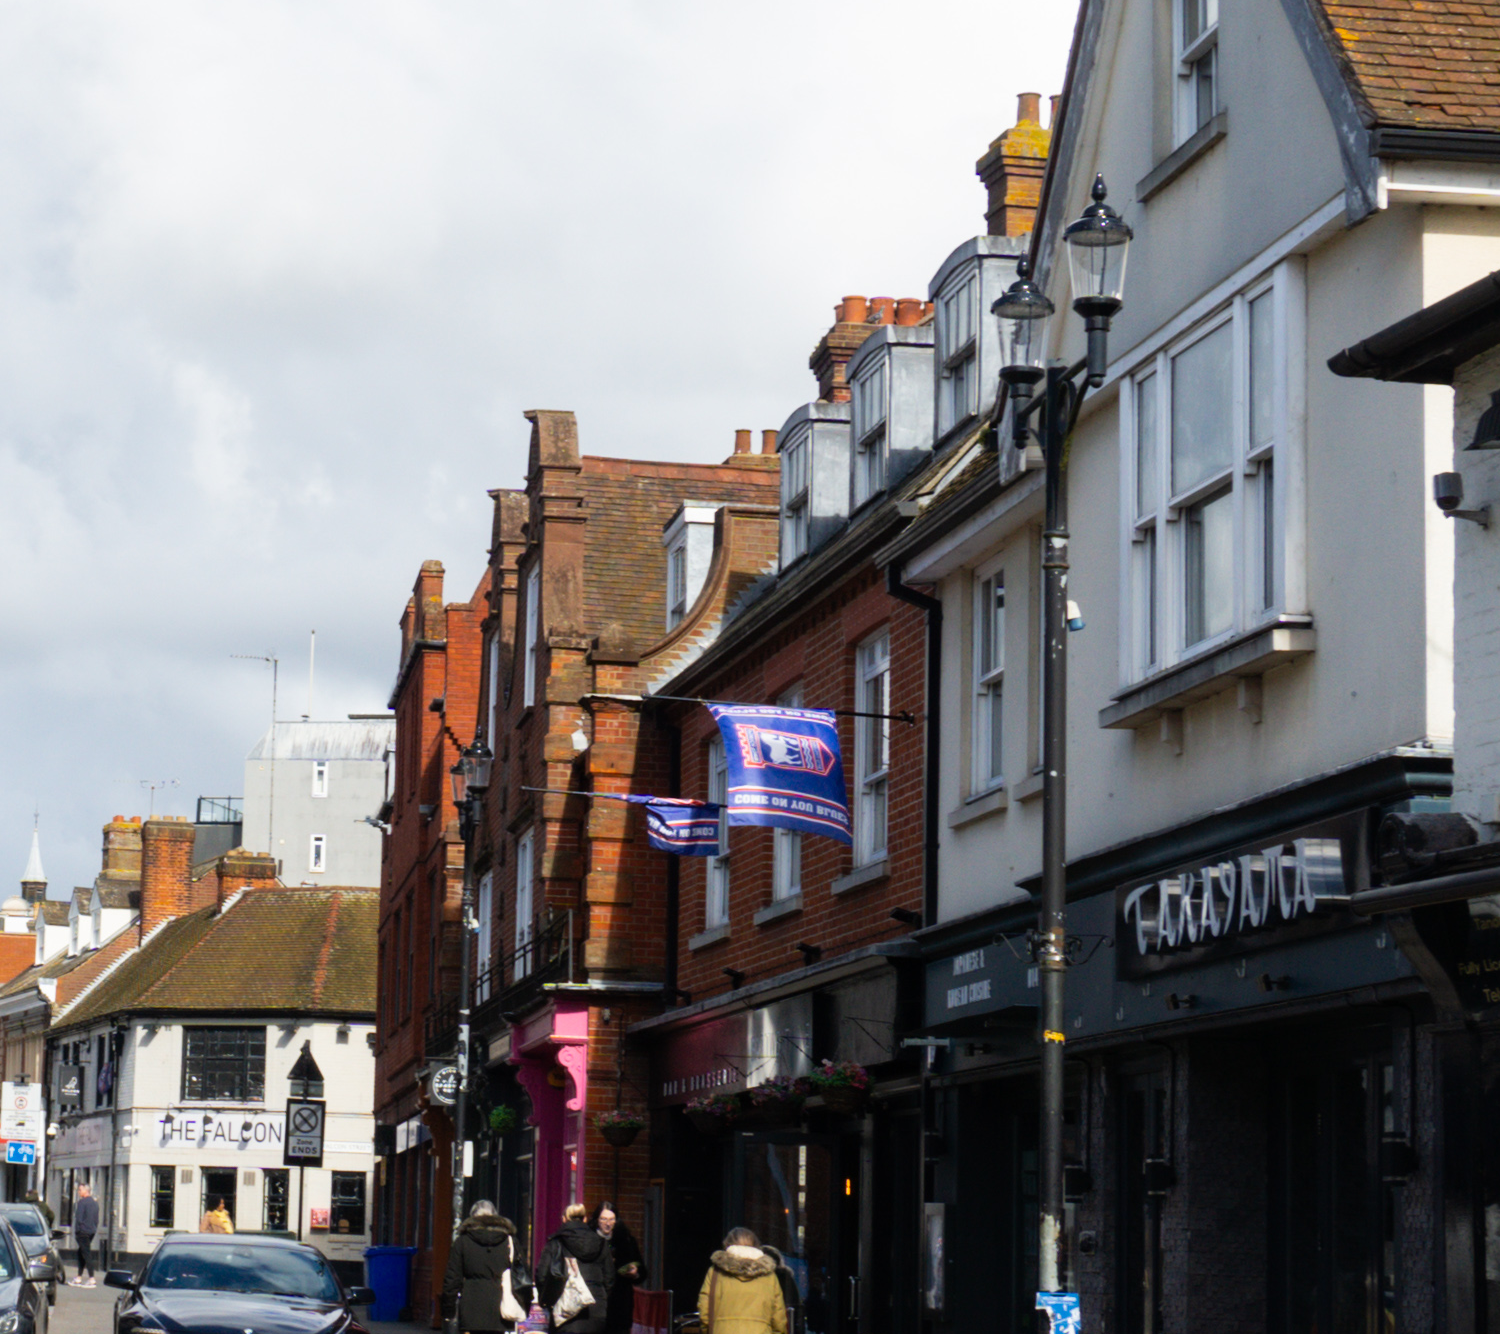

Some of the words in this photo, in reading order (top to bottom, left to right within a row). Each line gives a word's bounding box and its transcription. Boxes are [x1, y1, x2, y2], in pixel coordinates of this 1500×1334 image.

[1124, 837, 1330, 956] TAKAYAMA
[1458, 962, 1481, 976] Fully
[159, 1120, 196, 1141] THE
[202, 1121, 282, 1143] FALCON
[292, 1146, 318, 1154] ENDS
